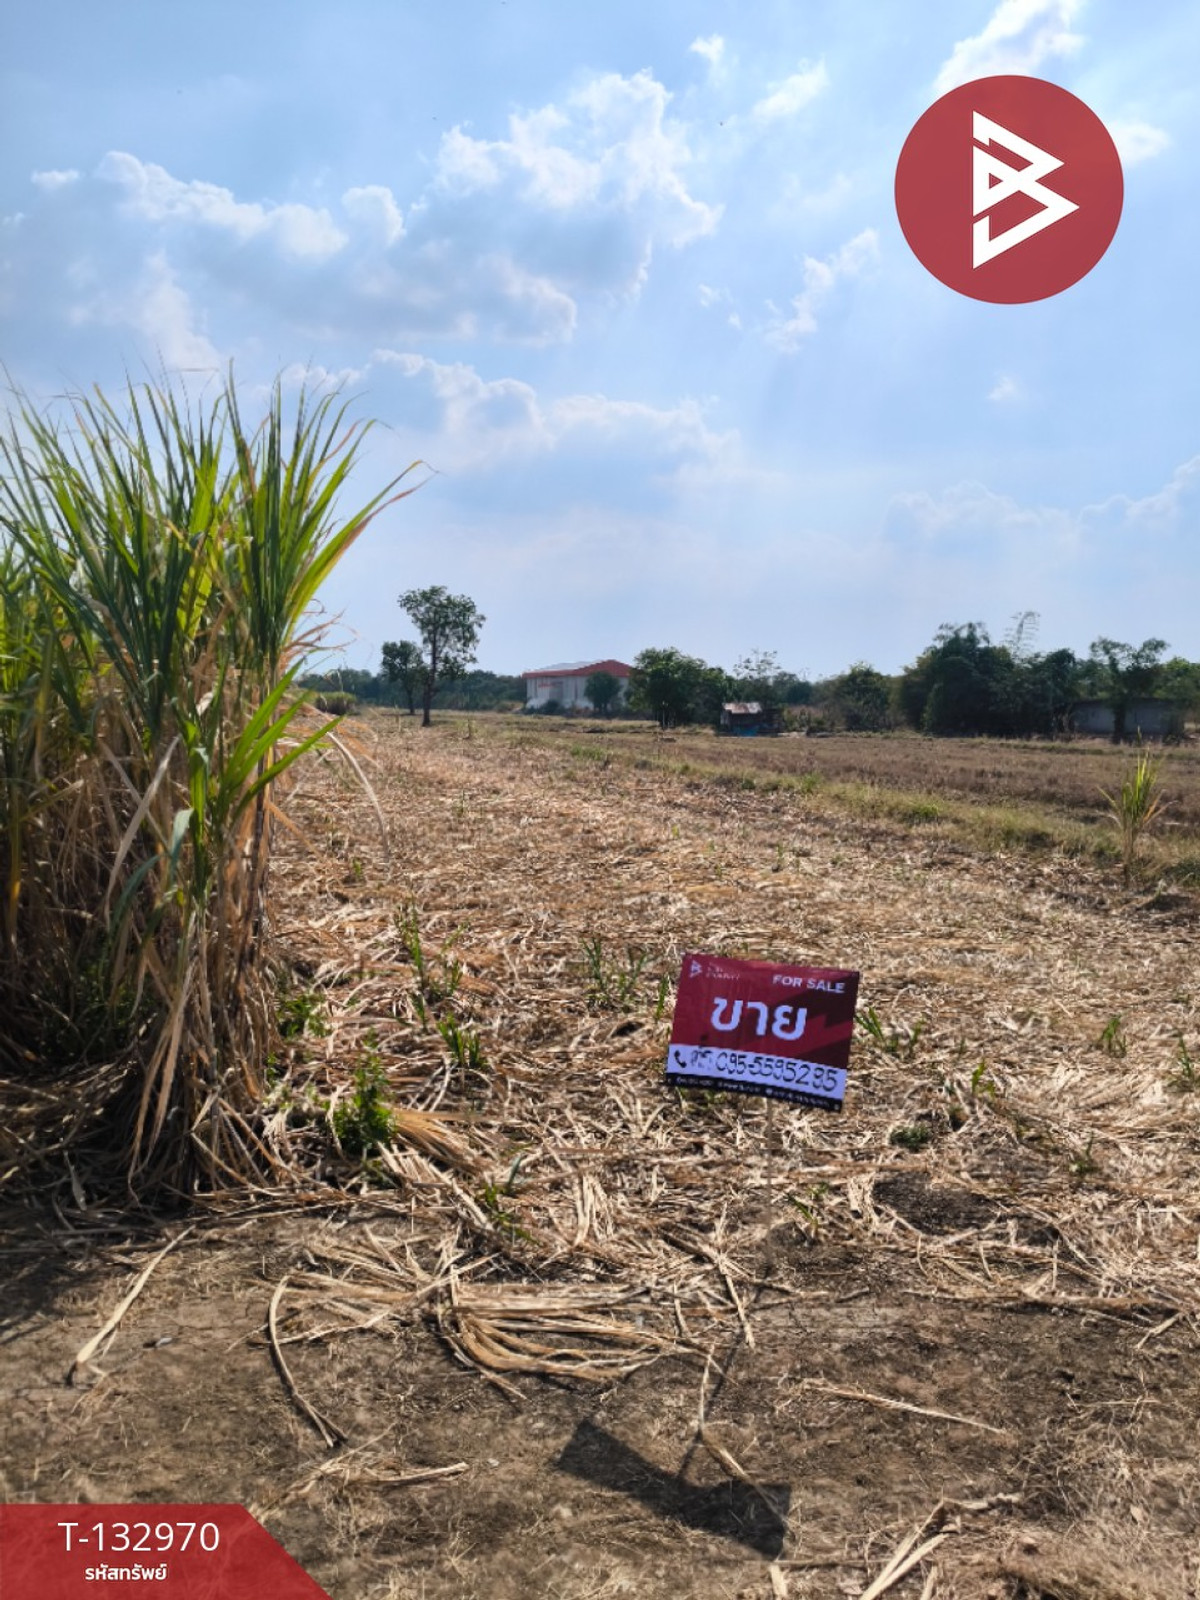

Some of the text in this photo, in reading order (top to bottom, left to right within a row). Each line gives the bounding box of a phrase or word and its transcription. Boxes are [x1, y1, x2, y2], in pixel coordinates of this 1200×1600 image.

[772, 974, 846, 994] FOR SALE
[711, 996, 808, 1040] ขาย
